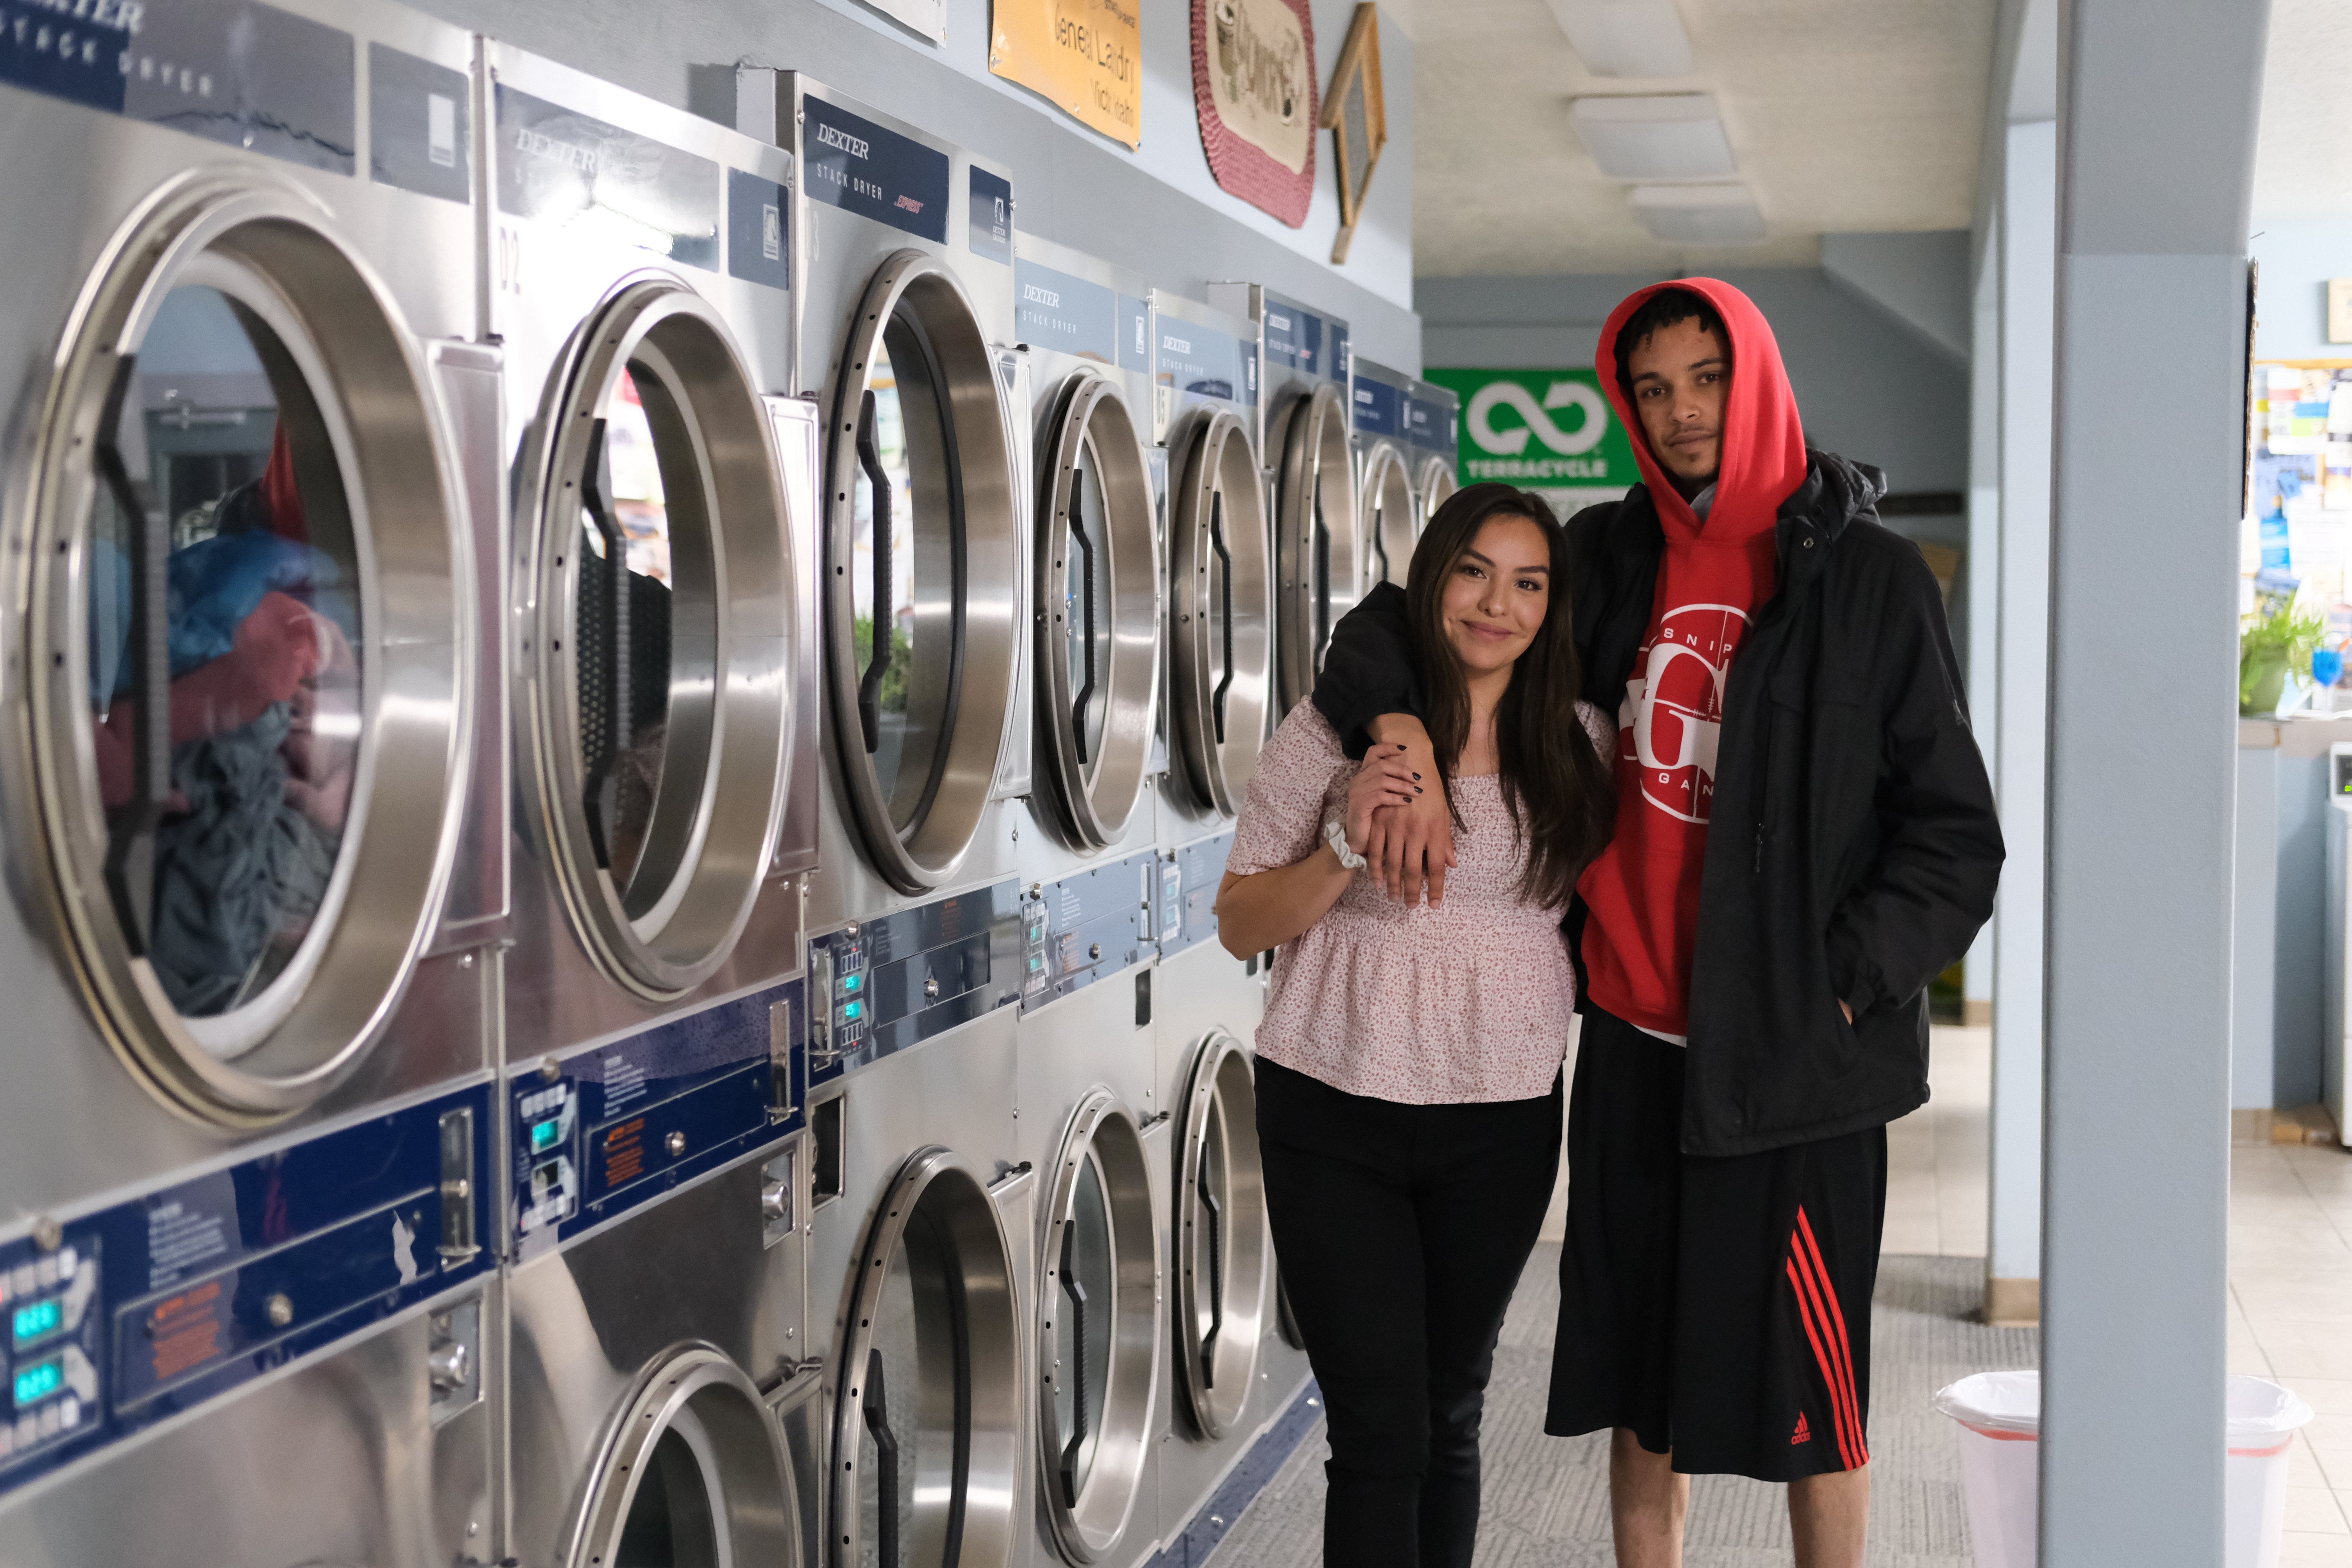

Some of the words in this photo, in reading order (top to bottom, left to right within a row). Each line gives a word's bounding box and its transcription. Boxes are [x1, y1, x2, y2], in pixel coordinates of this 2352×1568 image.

[515, 128, 595, 173] DEXTER
[817, 123, 869, 160] DEXTER
[817, 163, 848, 188] STACK
[854, 180, 882, 200] DRYER
[1023, 284, 1059, 308] DEXTER
[1023, 310, 1048, 327] STACK
[1053, 319, 1077, 335] DRYER
[1163, 336, 1191, 354] DEXTER
[1466, 458, 1608, 478] TERRACYCLE
[1791, 1430, 1811, 1445] adidas
